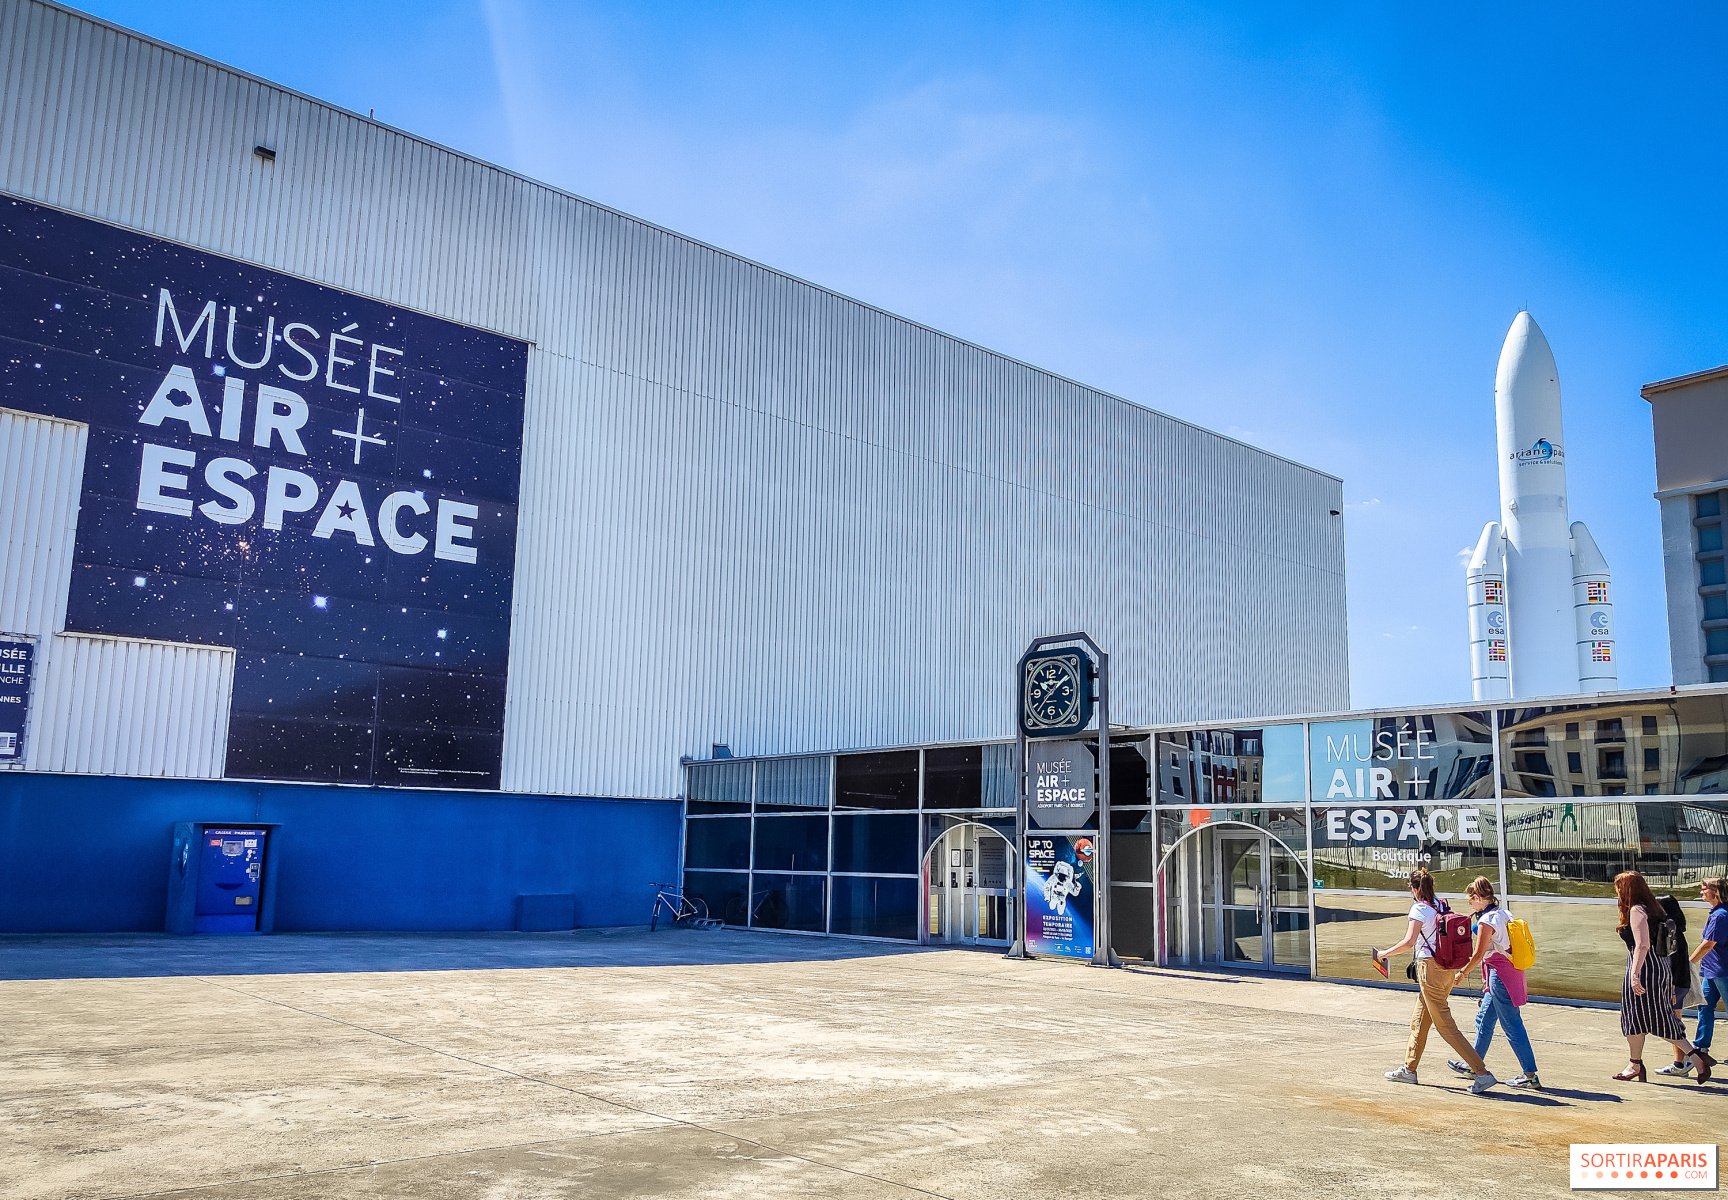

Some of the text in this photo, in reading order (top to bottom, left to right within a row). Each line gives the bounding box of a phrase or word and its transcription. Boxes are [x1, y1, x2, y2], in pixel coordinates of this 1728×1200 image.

[154, 288, 404, 403] MUSÉE
[139, 364, 310, 456] AIR
[136, 442, 479, 564] ESPACE
[1488, 627, 1505, 635] esa
[1591, 628, 1609, 636] esa
[0, 648, 27, 660] SÉE
[0, 663, 25, 674] LLE
[1046, 669, 1057, 679] 12
[1033, 685, 1070, 699] 9 3
[1047, 705, 1056, 716] 6
[1326, 723, 1435, 763] MUSÉE
[1036, 757, 1072, 774] MUSÉE
[1036, 775, 1059, 788] AIR
[1326, 767, 1394, 799] AIR
[1037, 788, 1086, 802] ESPACE
[1326, 808, 1482, 841] ESPACE
[1028, 840, 1053, 849] UP TO
[1028, 849, 1055, 859] SPACE
[1372, 851, 1432, 868] Boutique
[1388, 869, 1411, 879] Sho
[1042, 921, 1073, 929] TEMPORAIRE
